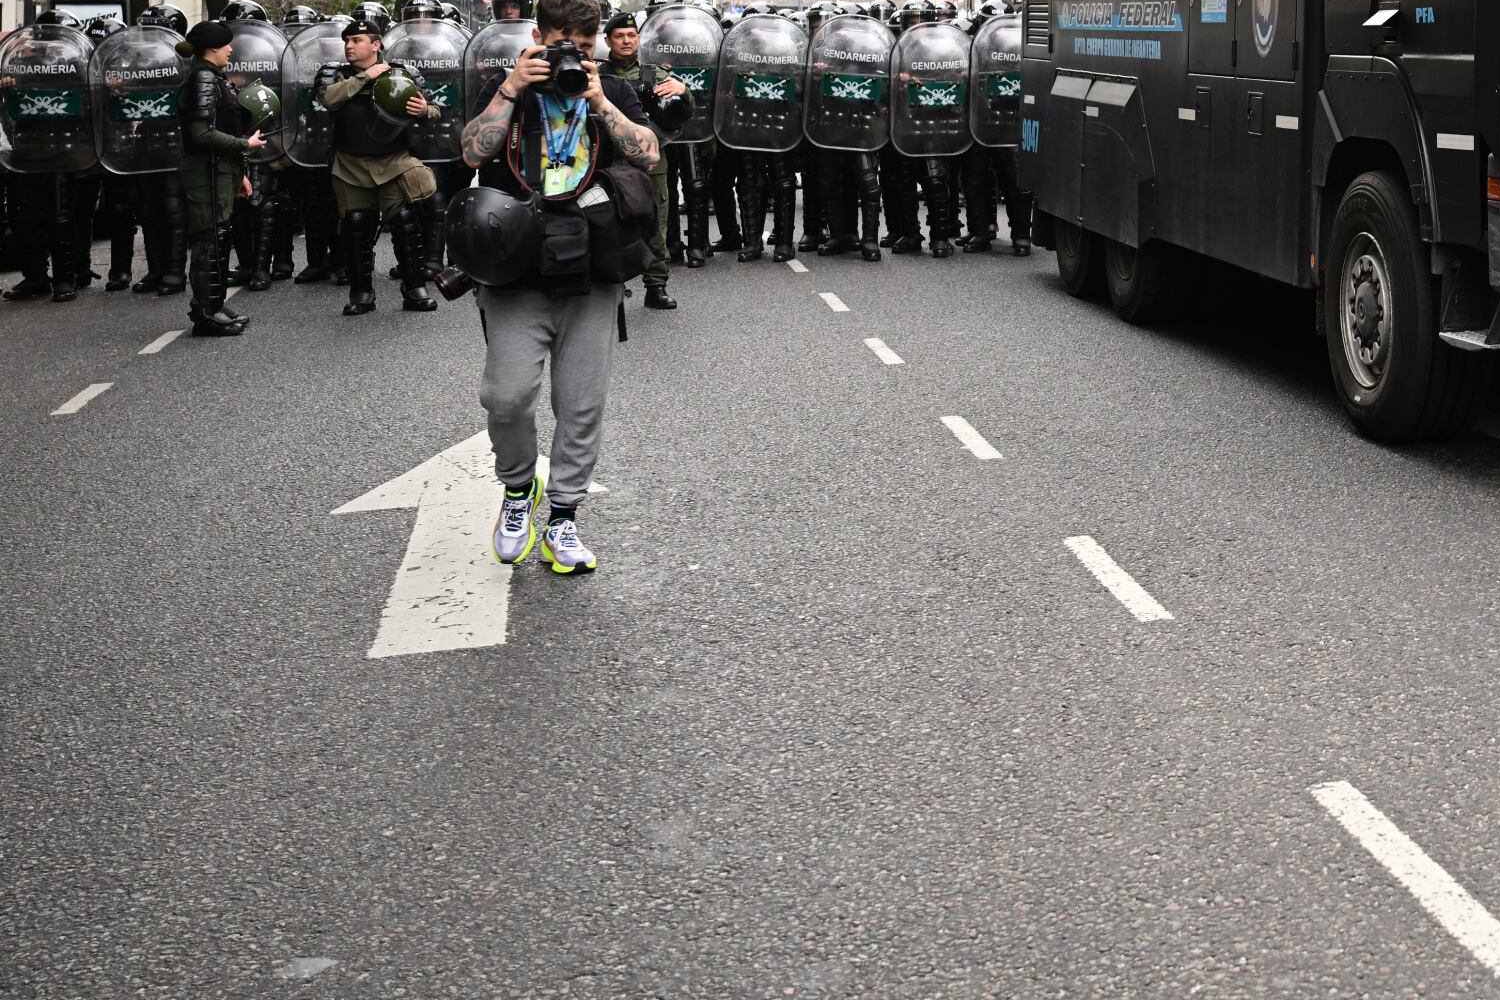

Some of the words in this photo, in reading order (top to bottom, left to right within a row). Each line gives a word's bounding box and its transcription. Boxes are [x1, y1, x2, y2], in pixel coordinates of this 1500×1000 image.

[1069, 2, 1113, 27] POLICIA
[1117, 1, 1176, 28] FEDERAL
[1415, 6, 1435, 24] PFA
[91, 29, 106, 37] GNA
[737, 51, 799, 65] GENDARMERIA
[823, 48, 885, 63] GENDARMERIA
[105, 66, 179, 80] GENDARMERIA
[510, 122, 519, 150] Canon
